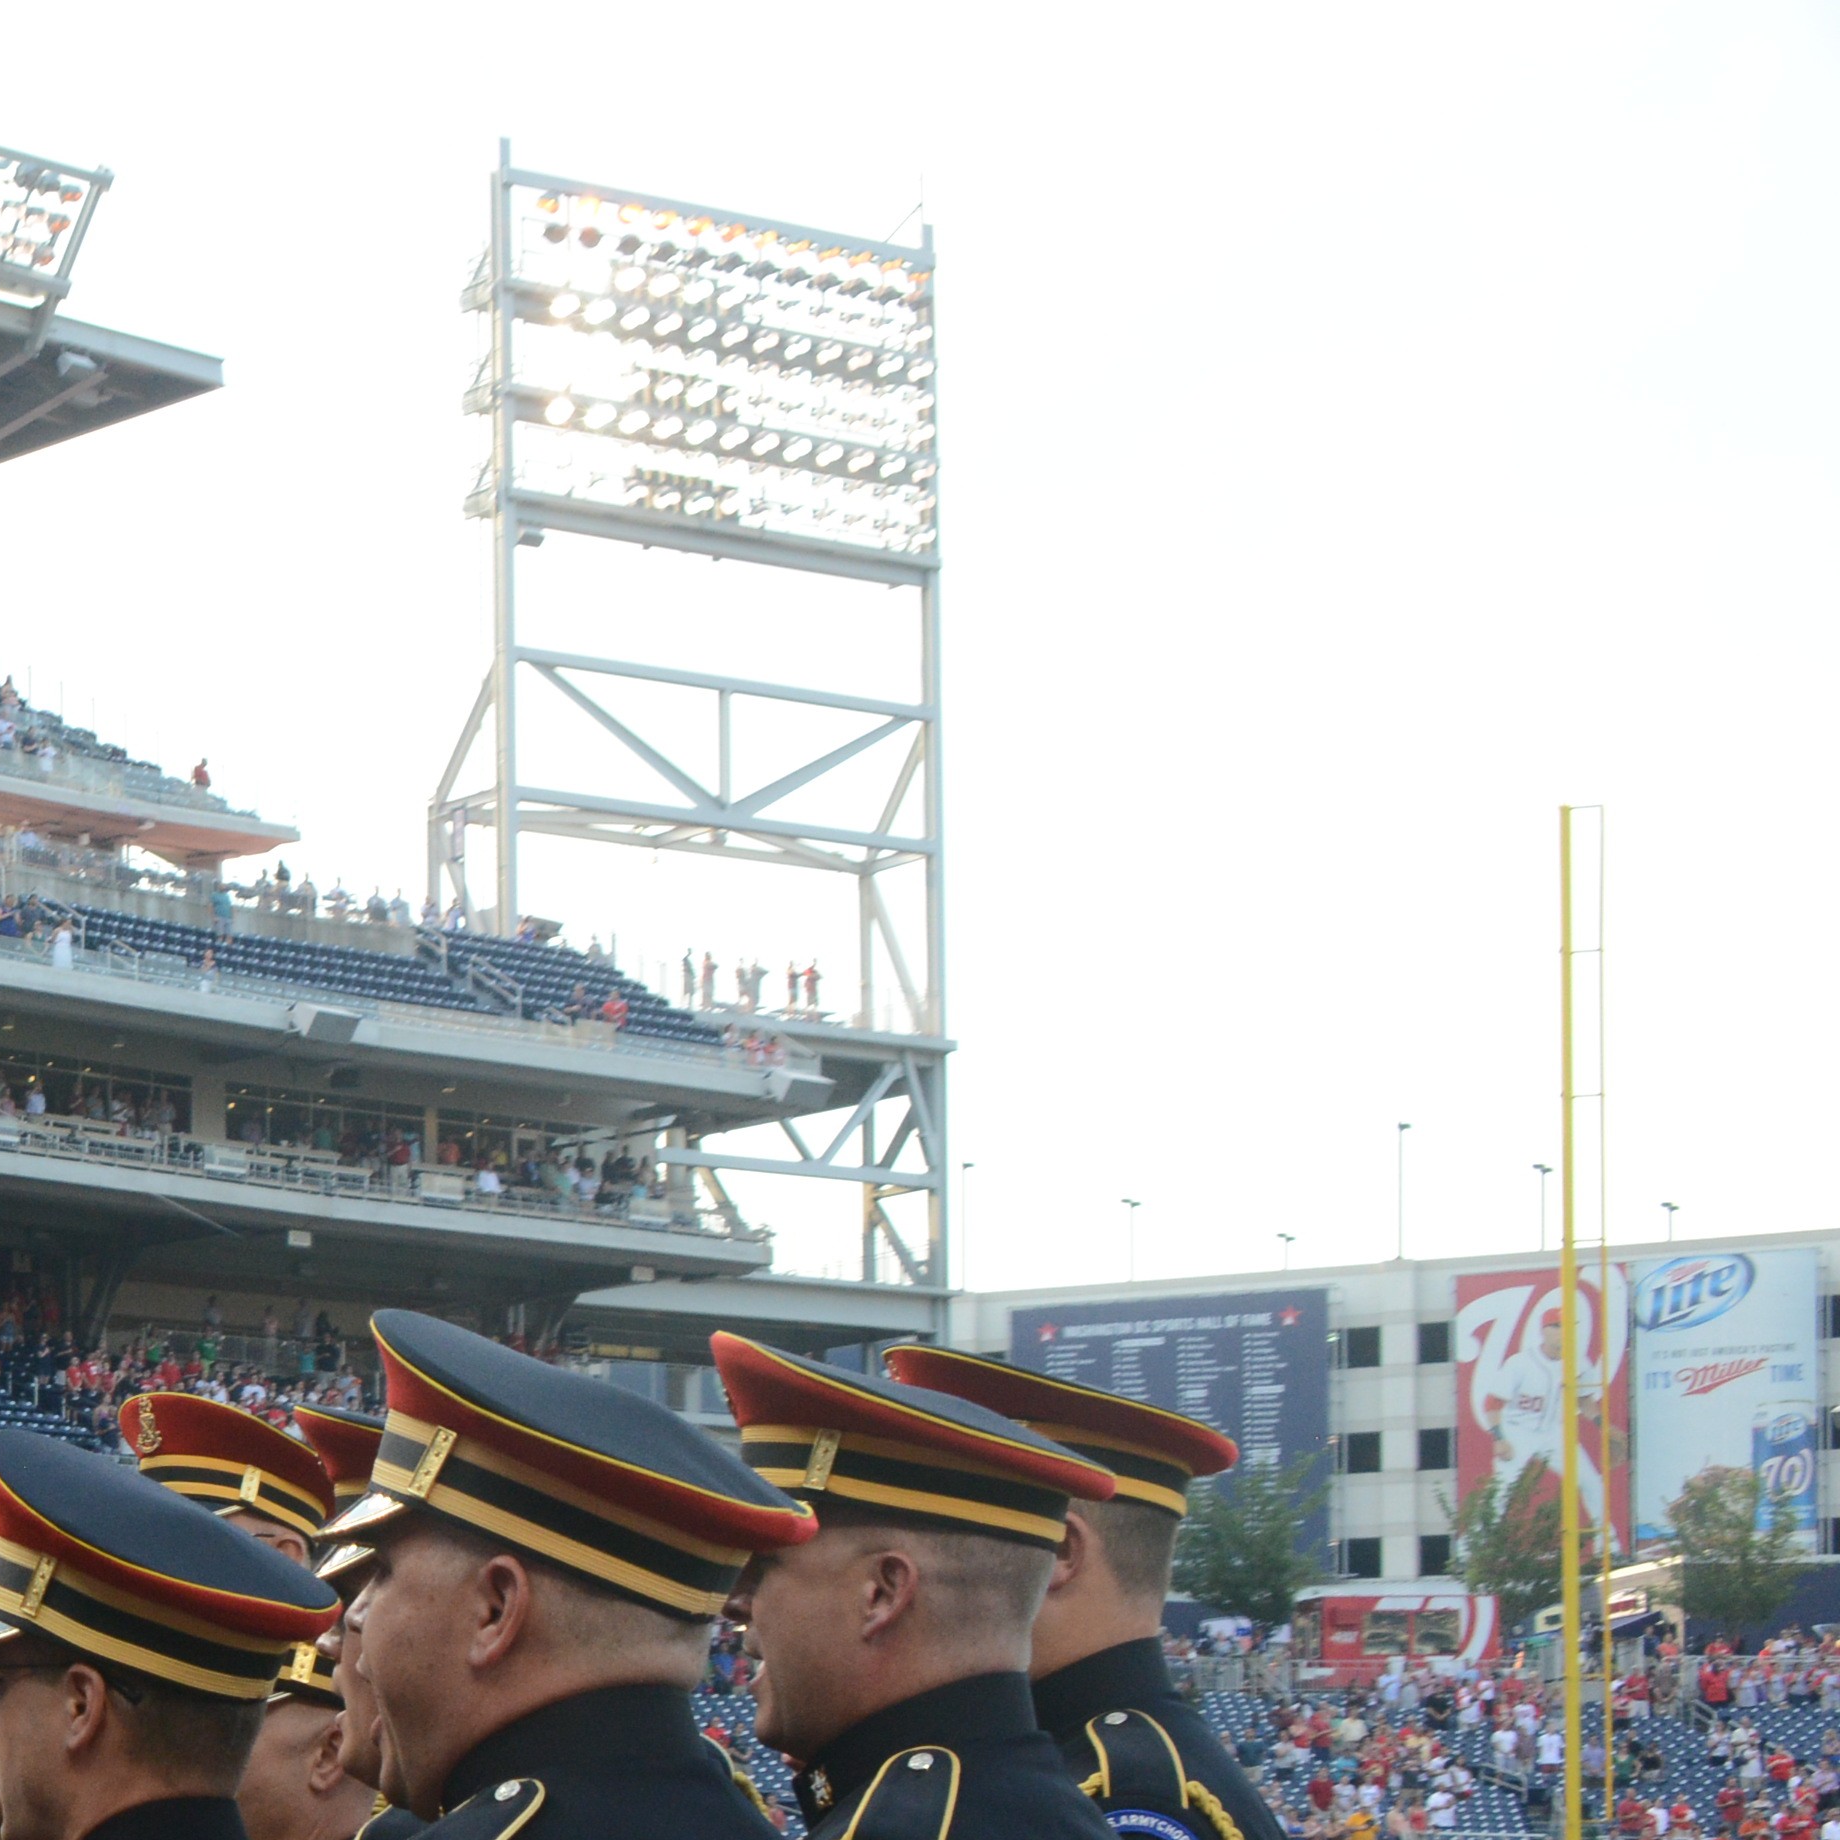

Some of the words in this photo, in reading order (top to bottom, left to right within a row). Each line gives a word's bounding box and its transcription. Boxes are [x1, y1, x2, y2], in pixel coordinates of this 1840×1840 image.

[1645, 1263, 1738, 1333] Lite
[1674, 1357, 1770, 1397] Miller
[1120, 1814, 1161, 1829] ARMY
